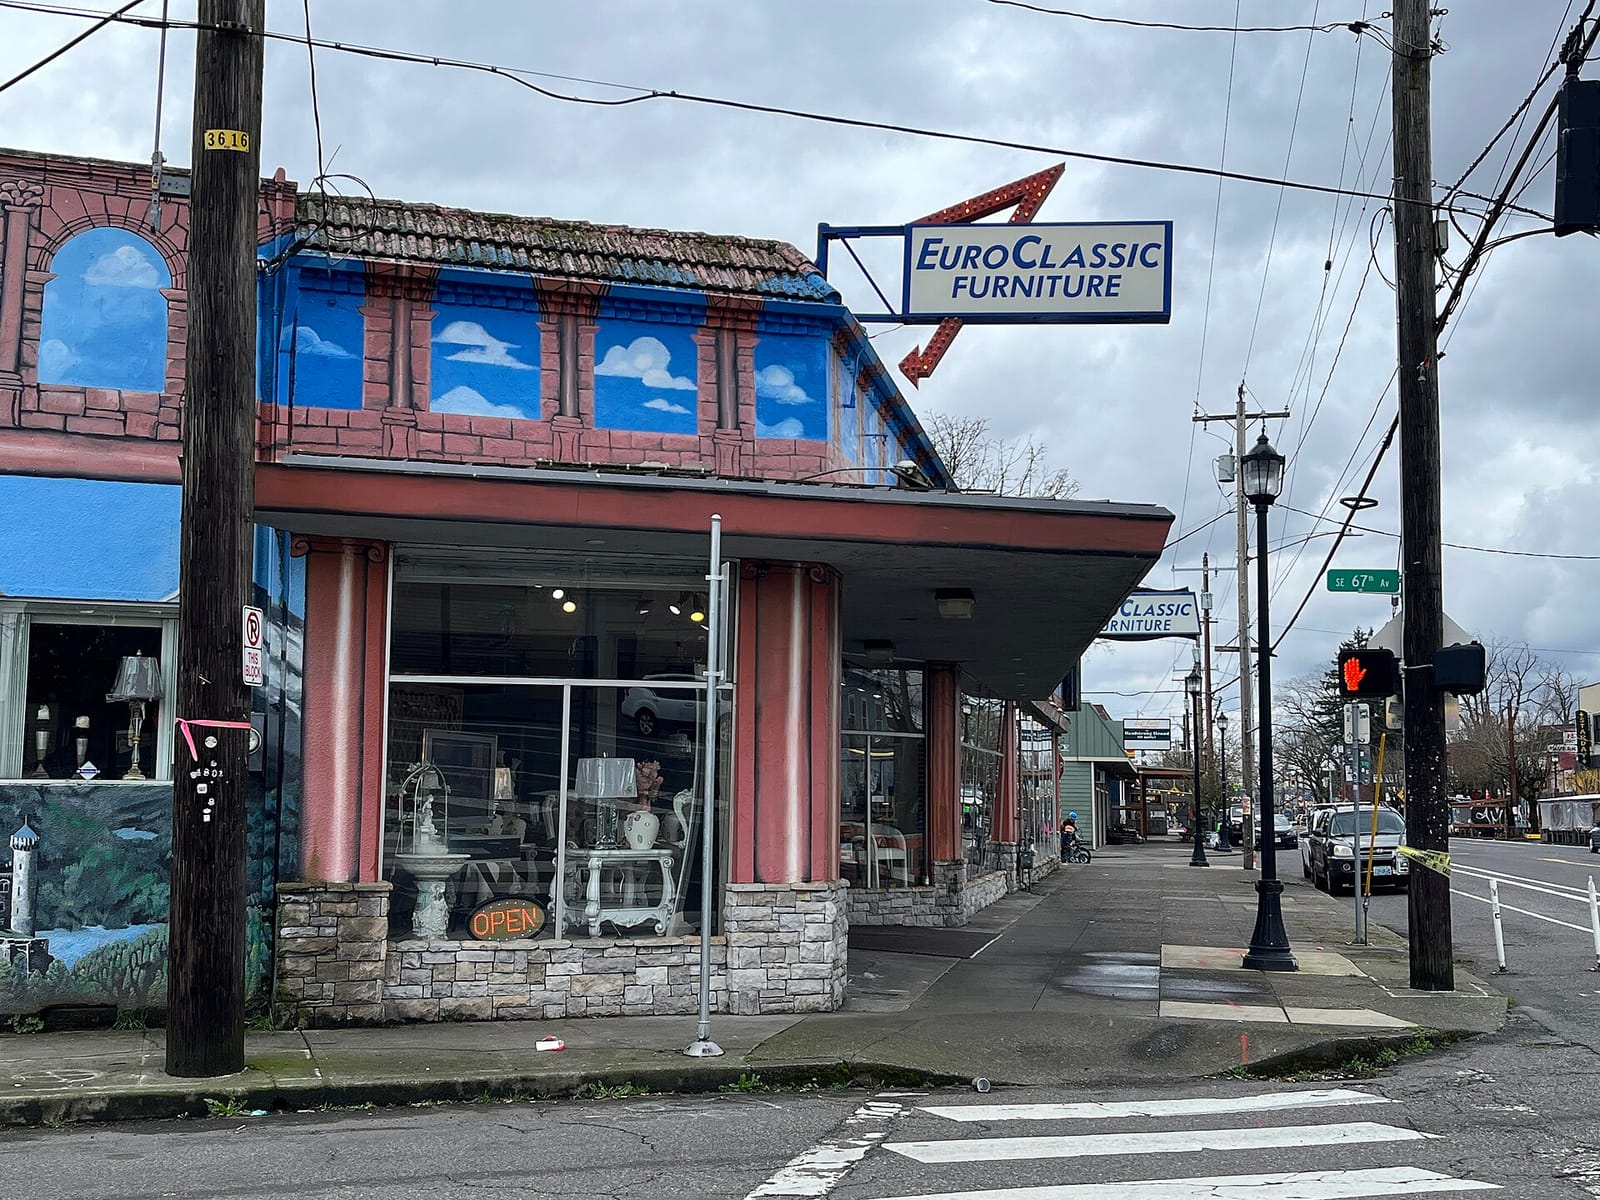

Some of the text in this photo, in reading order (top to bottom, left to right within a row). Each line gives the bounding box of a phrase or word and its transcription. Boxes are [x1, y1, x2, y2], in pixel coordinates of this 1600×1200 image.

[207, 131, 248, 147] 3616
[951, 274, 1122, 299] FURNITURE
[1335, 577, 1345, 587] SE
[248, 651, 258, 665] THIS
[245, 665, 262, 678] BLOCK
[1579, 717, 1587, 760] STARDAY
[473, 907, 537, 936] OPEN
